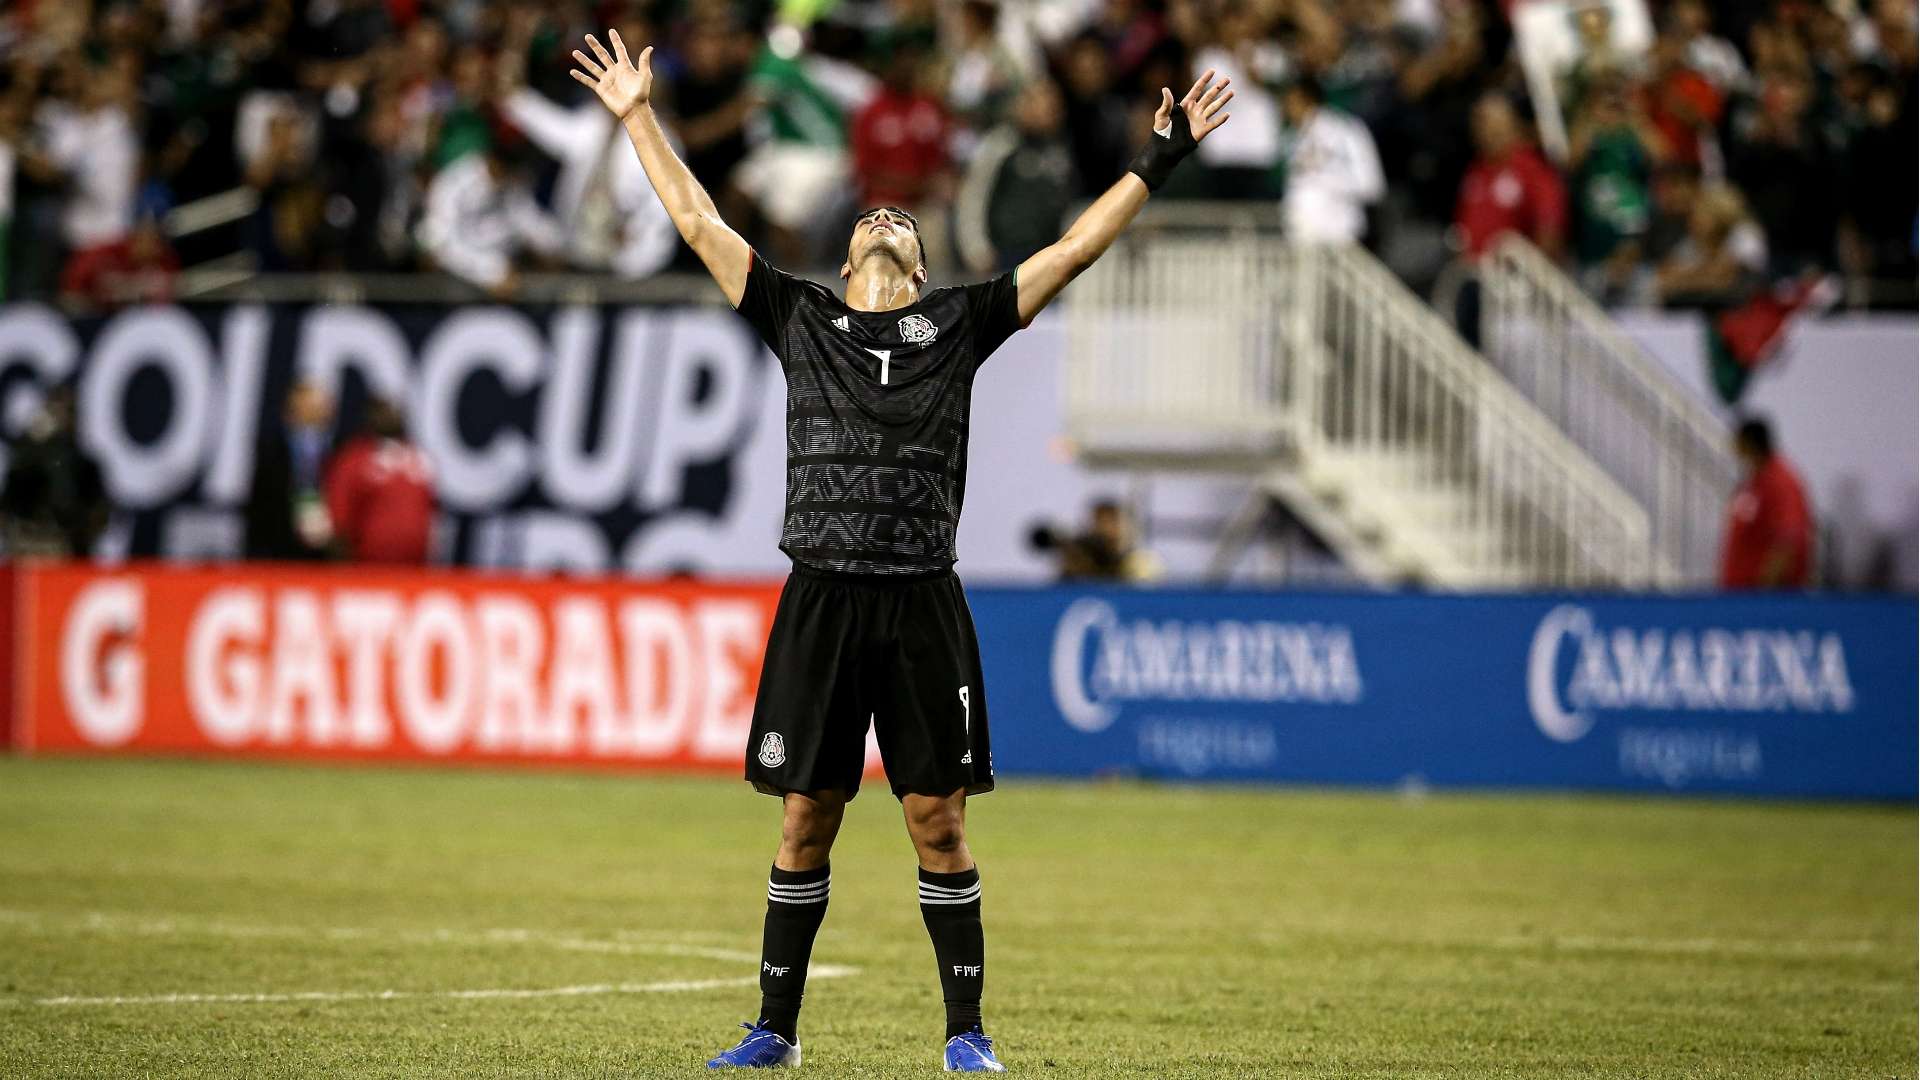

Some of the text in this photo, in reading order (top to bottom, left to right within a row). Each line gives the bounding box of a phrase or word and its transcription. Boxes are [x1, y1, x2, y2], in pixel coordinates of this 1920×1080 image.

[60, 577, 764, 758] G GATORADE
[1051, 597, 1362, 731] CAMARENA
[1527, 604, 1855, 741] CAMARENA
[763, 960, 790, 977] FMF
[953, 965, 981, 977] FMF
